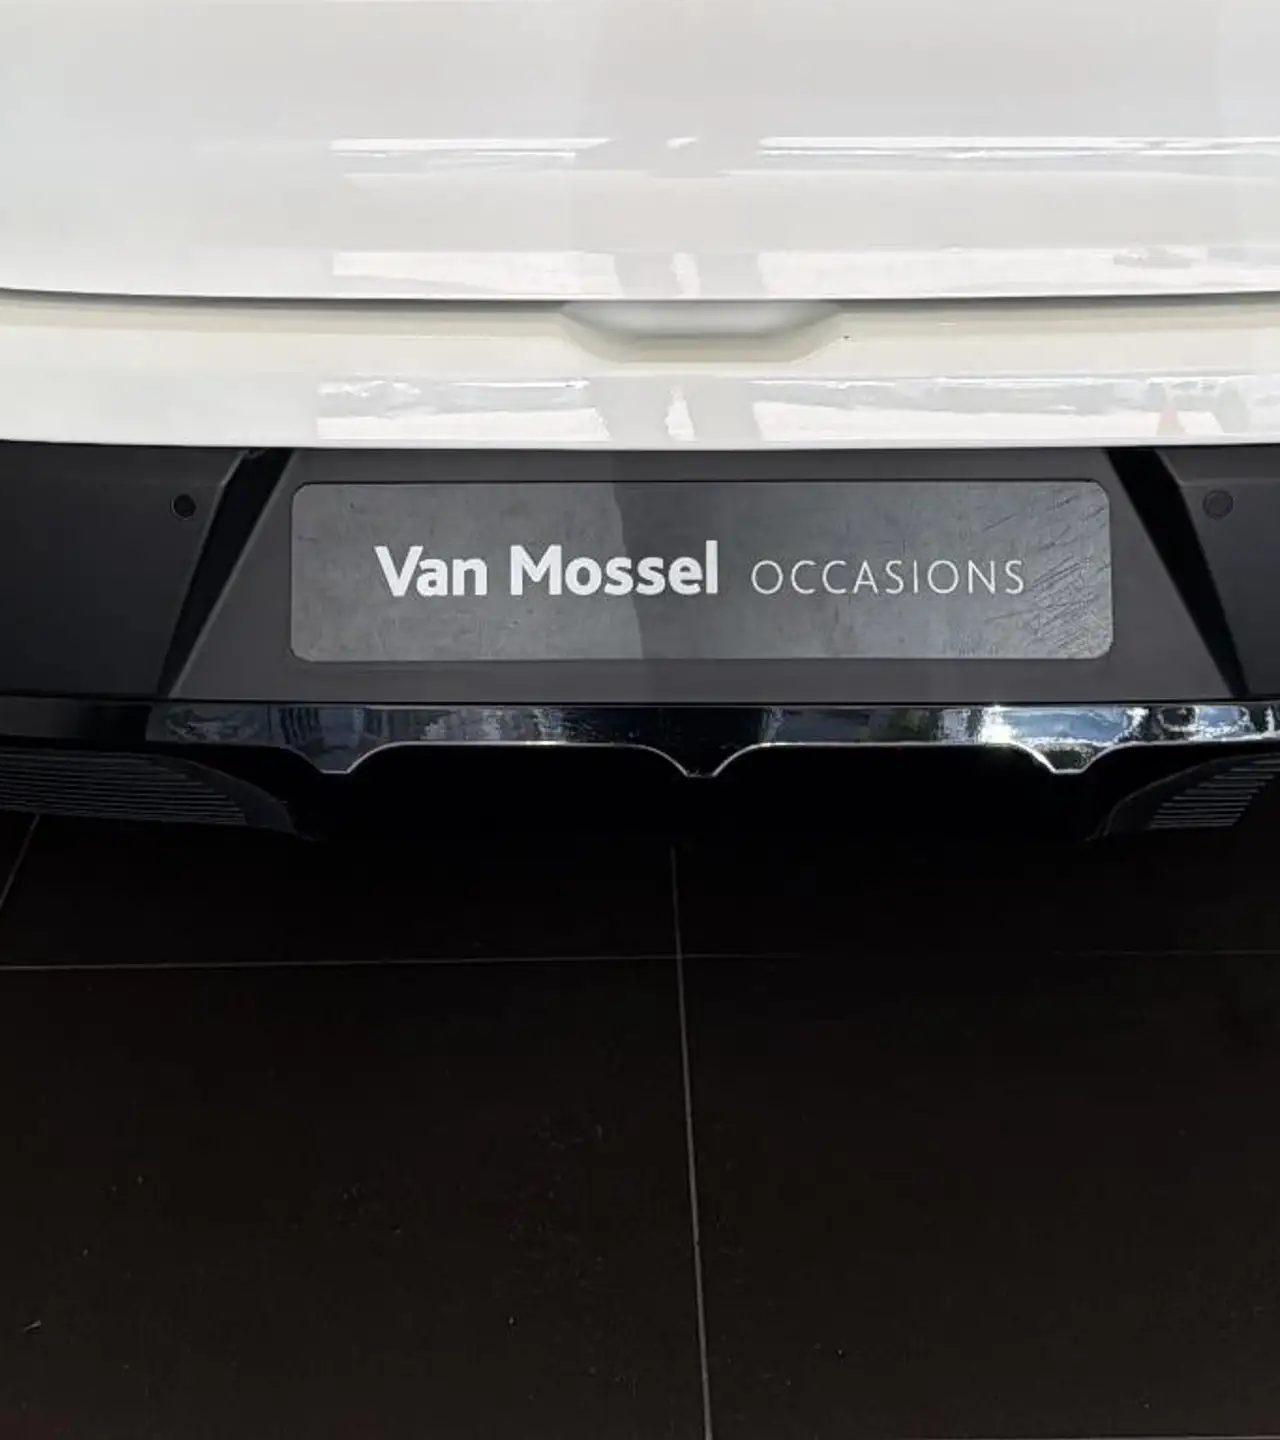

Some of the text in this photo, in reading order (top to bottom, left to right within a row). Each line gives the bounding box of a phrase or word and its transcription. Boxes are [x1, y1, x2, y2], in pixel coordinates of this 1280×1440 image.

[374, 539, 1027, 598] Van Mossel OCCASIONS
